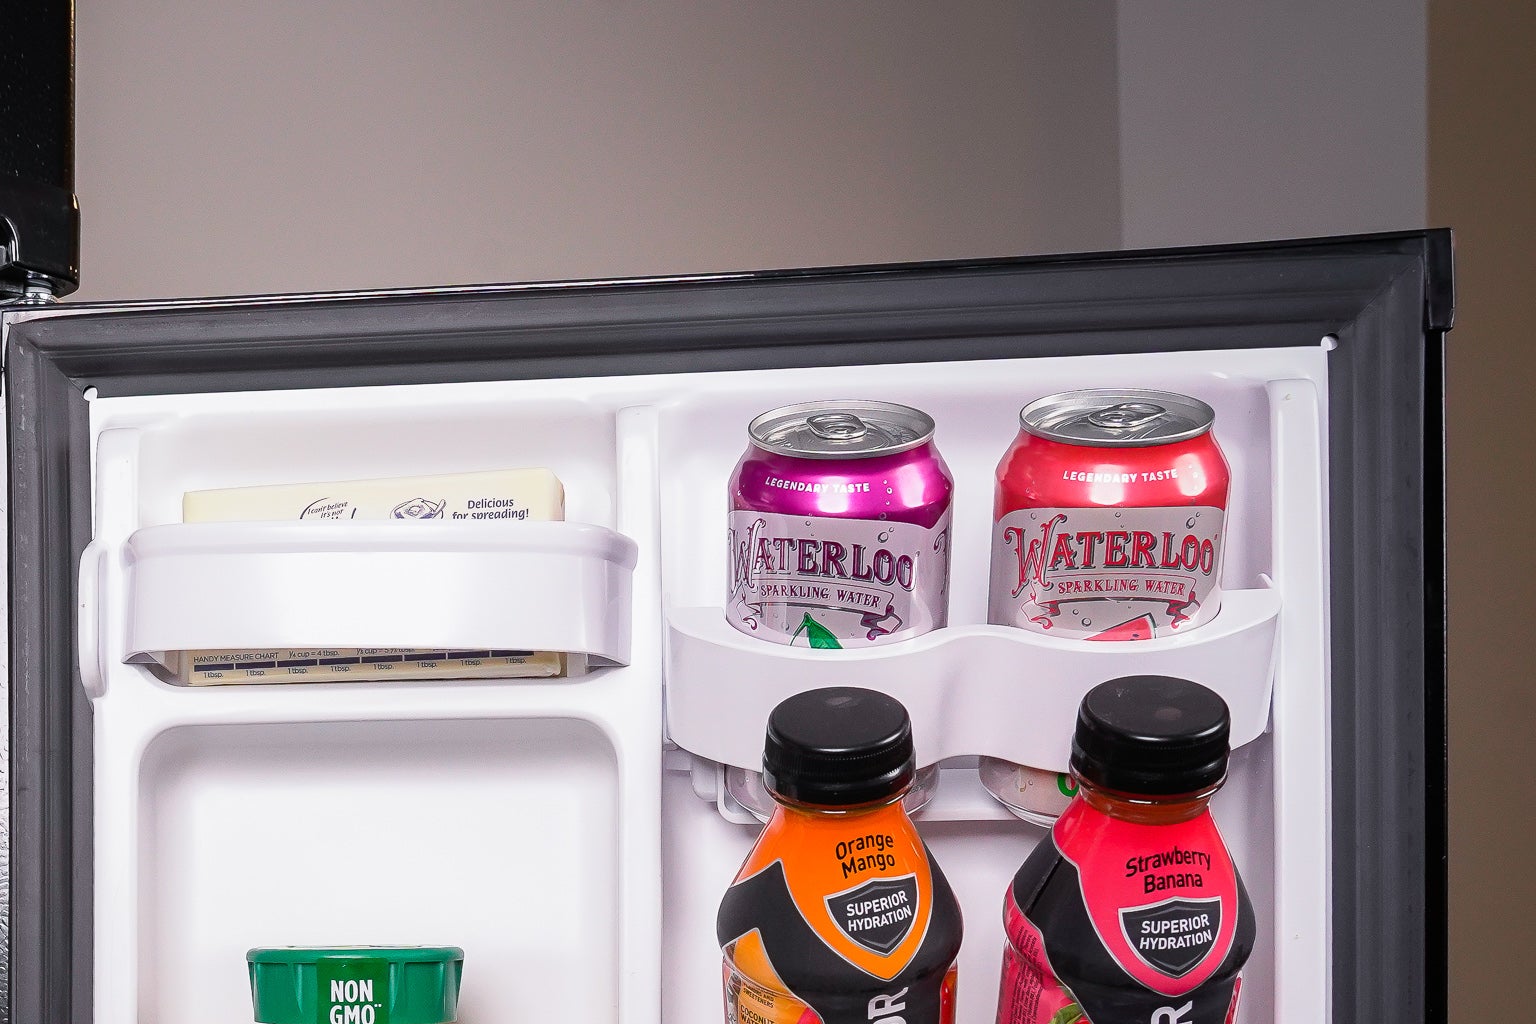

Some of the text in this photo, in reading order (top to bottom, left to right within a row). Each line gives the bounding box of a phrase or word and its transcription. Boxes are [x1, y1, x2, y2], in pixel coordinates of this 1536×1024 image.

[765, 477, 870, 493] LEGENDARY TASTE
[1063, 469, 1178, 483] LEGENDARY TASTE
[453, 508, 529, 519] for spreading!
[467, 499, 514, 509] Delicious
[729, 518, 919, 595] WATERLOO
[1004, 514, 1213, 598] WATERLOO
[760, 586, 881, 608] SPARKLING WATER
[1058, 579, 1186, 595] SPARKLING WATER
[220, 654, 253, 662] MEASURE
[255, 652, 279, 660] CHART
[836, 834, 893, 860] Orange
[842, 854, 895, 879] Mango
[1126, 846, 1210, 877] Strawberry
[1144, 873, 1203, 894] Banana
[846, 890, 908, 917] SUPERIOR
[848, 905, 912, 932] HYDRATION
[1141, 914, 1210, 934] SUPERIOR
[1139, 929, 1212, 949] HYDRATION
[331, 980, 373, 1003] NON
